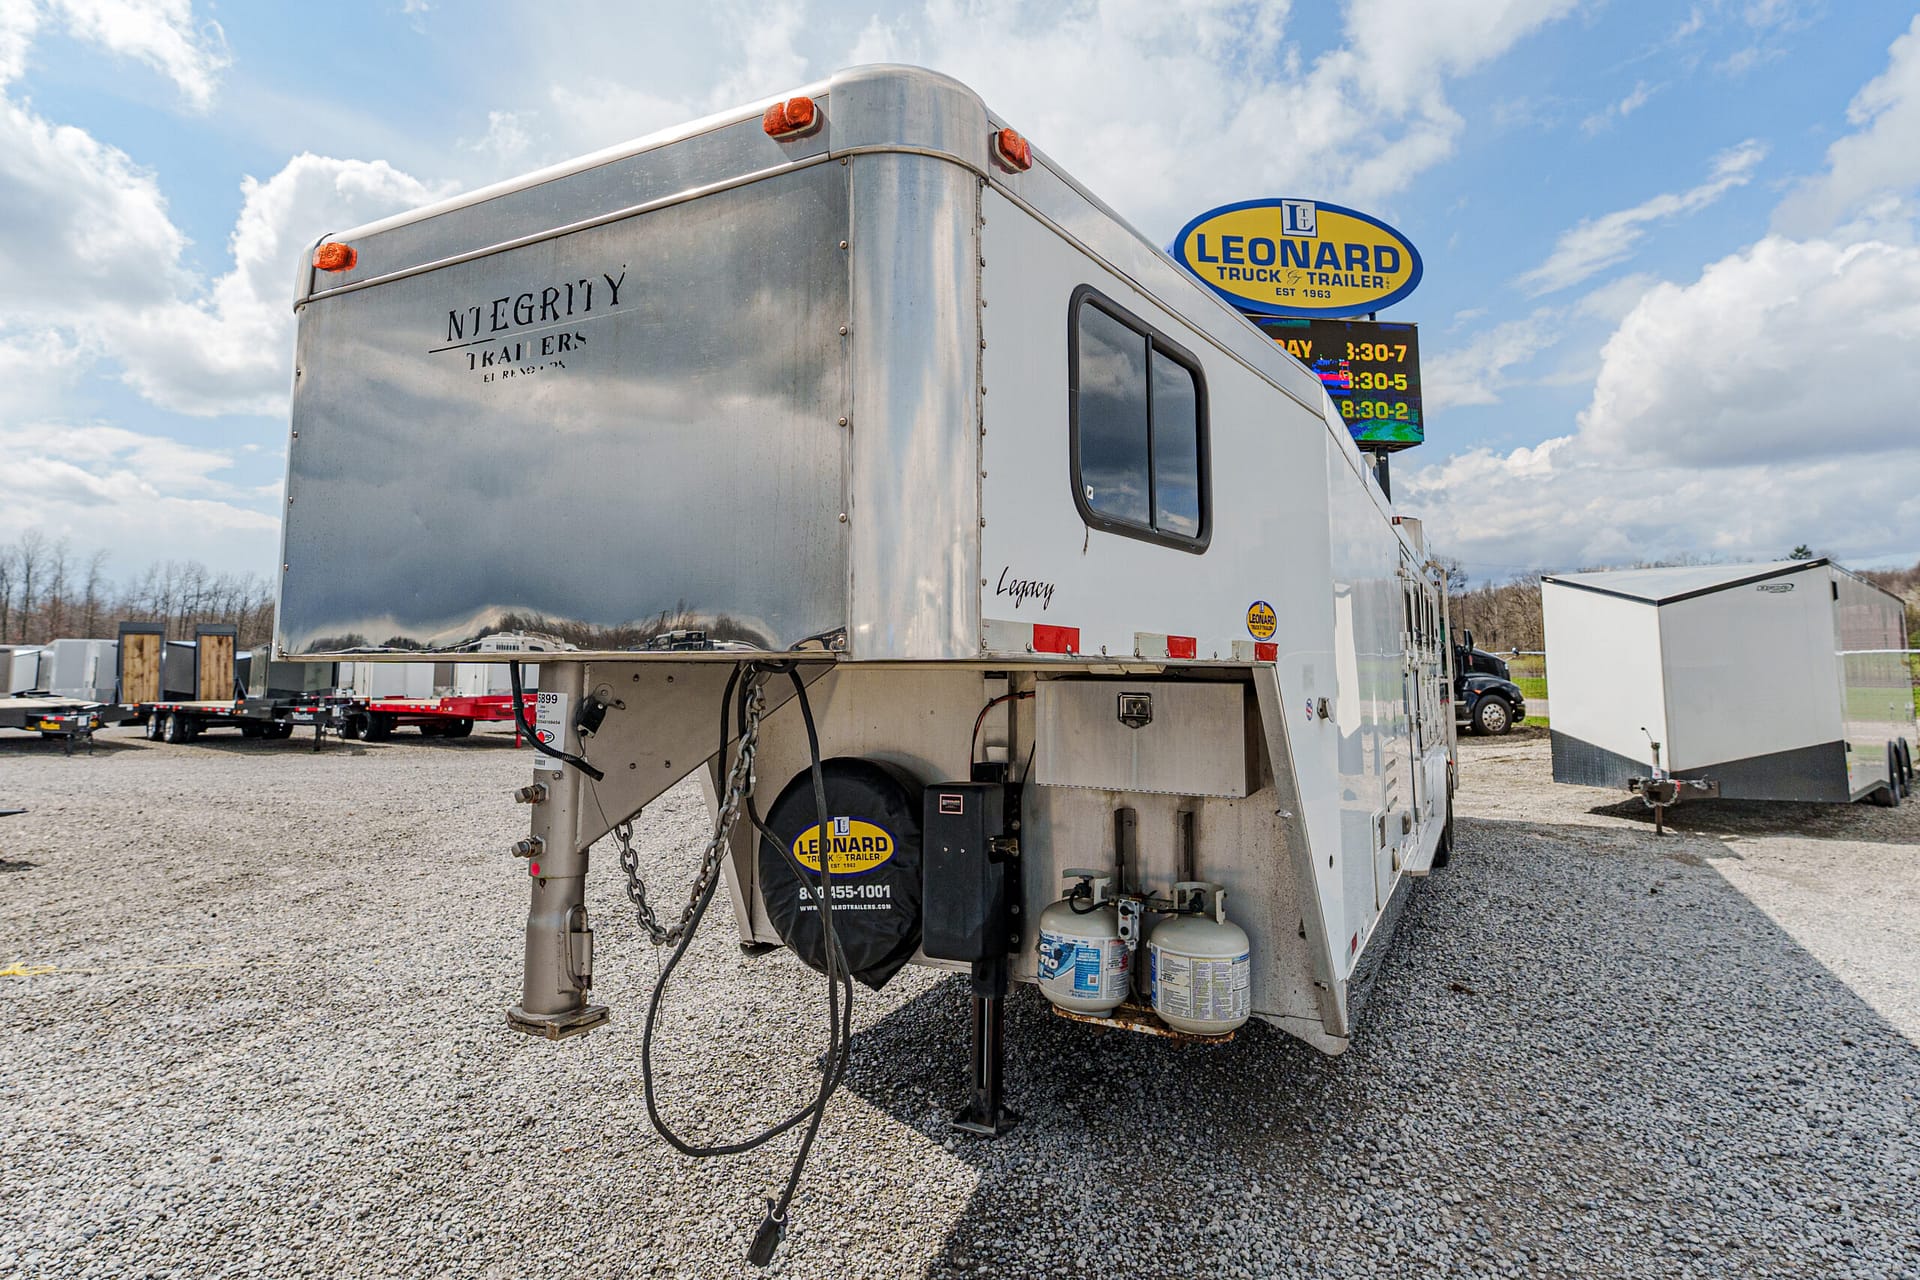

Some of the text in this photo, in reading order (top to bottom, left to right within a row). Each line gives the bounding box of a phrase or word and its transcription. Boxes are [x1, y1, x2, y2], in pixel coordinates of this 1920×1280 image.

[1197, 233, 1401, 274] LEONARD
[1216, 266, 1282, 283] TRUCK
[1306, 271, 1384, 289] TRAILER
[1275, 287, 1331, 299] EST 1963
[466, 331, 587, 370] TRAIERS
[1341, 400, 1409, 420] 8:30-2
[996, 566, 1055, 611] Legacy
[807, 853, 834, 863] TRK
[845, 853, 881, 861] TRAILER
[799, 884, 891, 900] 80455-1001
